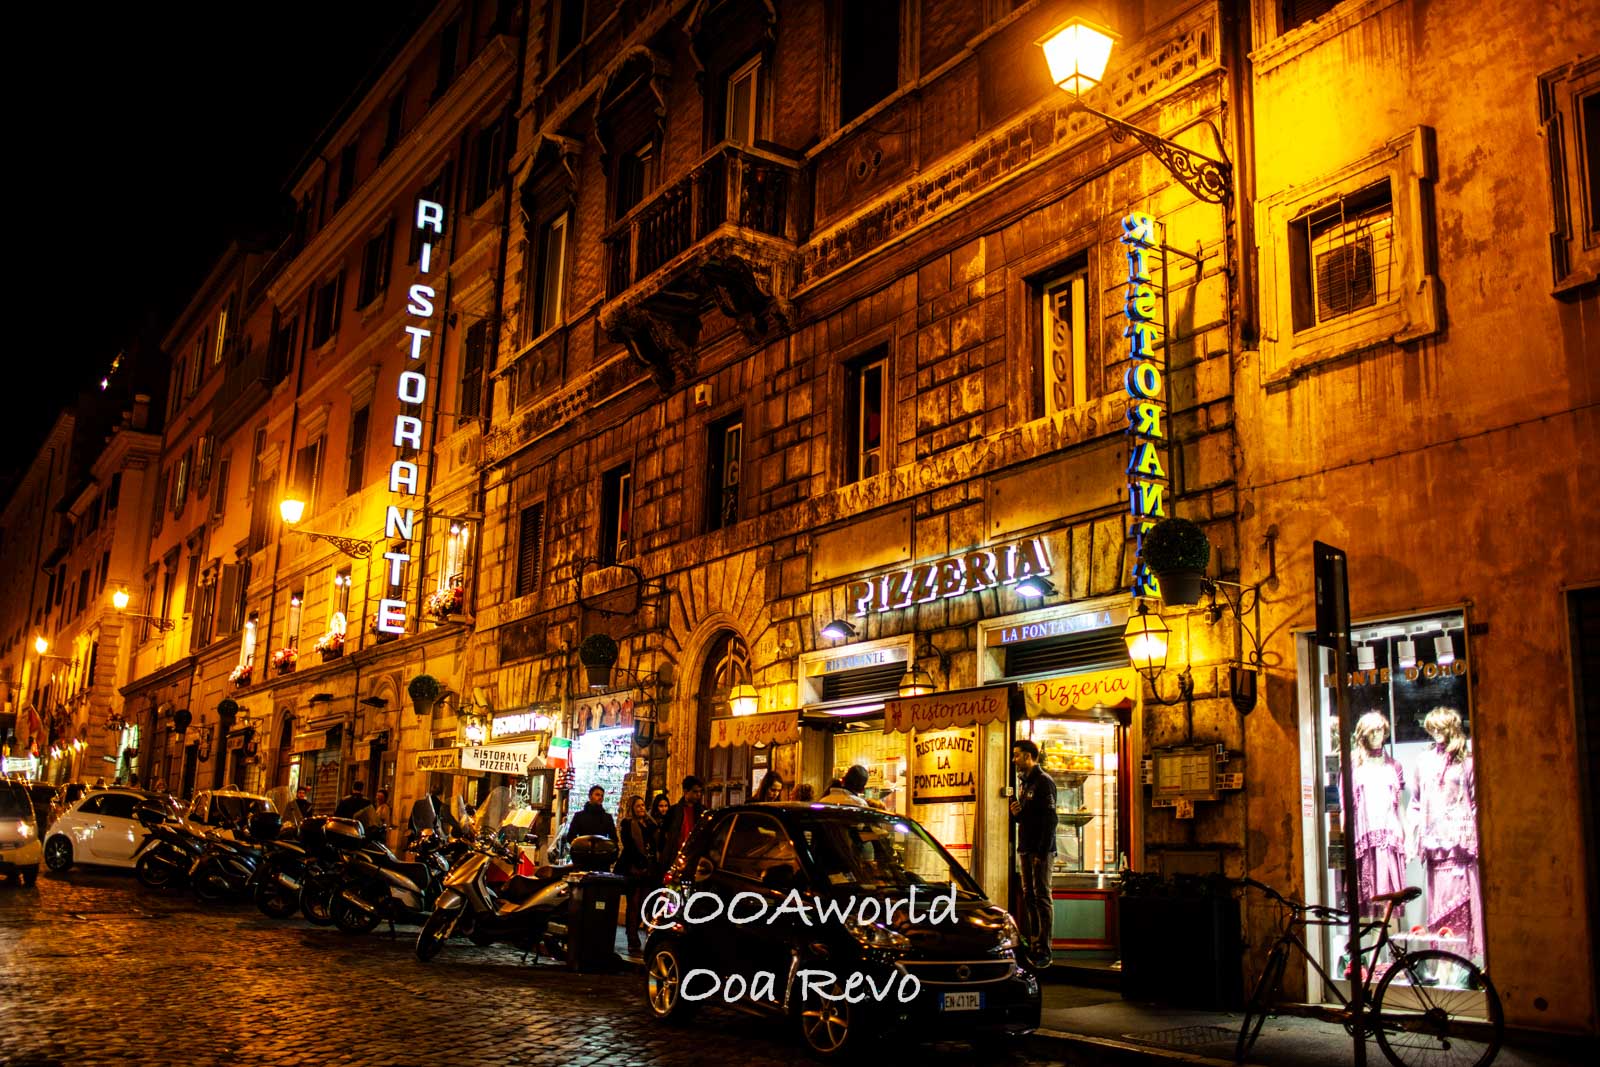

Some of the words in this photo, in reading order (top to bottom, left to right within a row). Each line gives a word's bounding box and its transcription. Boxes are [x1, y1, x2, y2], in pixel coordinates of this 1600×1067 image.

[377, 199, 443, 635] RISTORANTE
[847, 537, 1052, 616] PIZZERIA
[1002, 628, 1018, 643] LA
[1405, 659, 1466, 682] D'ORO
[1035, 676, 1130, 707] Pizzeria
[911, 697, 1000, 723] Ristorante
[736, 720, 788, 740] Pizzeria
[473, 749, 528, 763] RISTORANTE
[915, 736, 974, 758] RISTORANTE
[480, 759, 519, 772] PIZZERIA
[937, 757, 951, 770] LA
[914, 771, 975, 790] FONTANELLA
